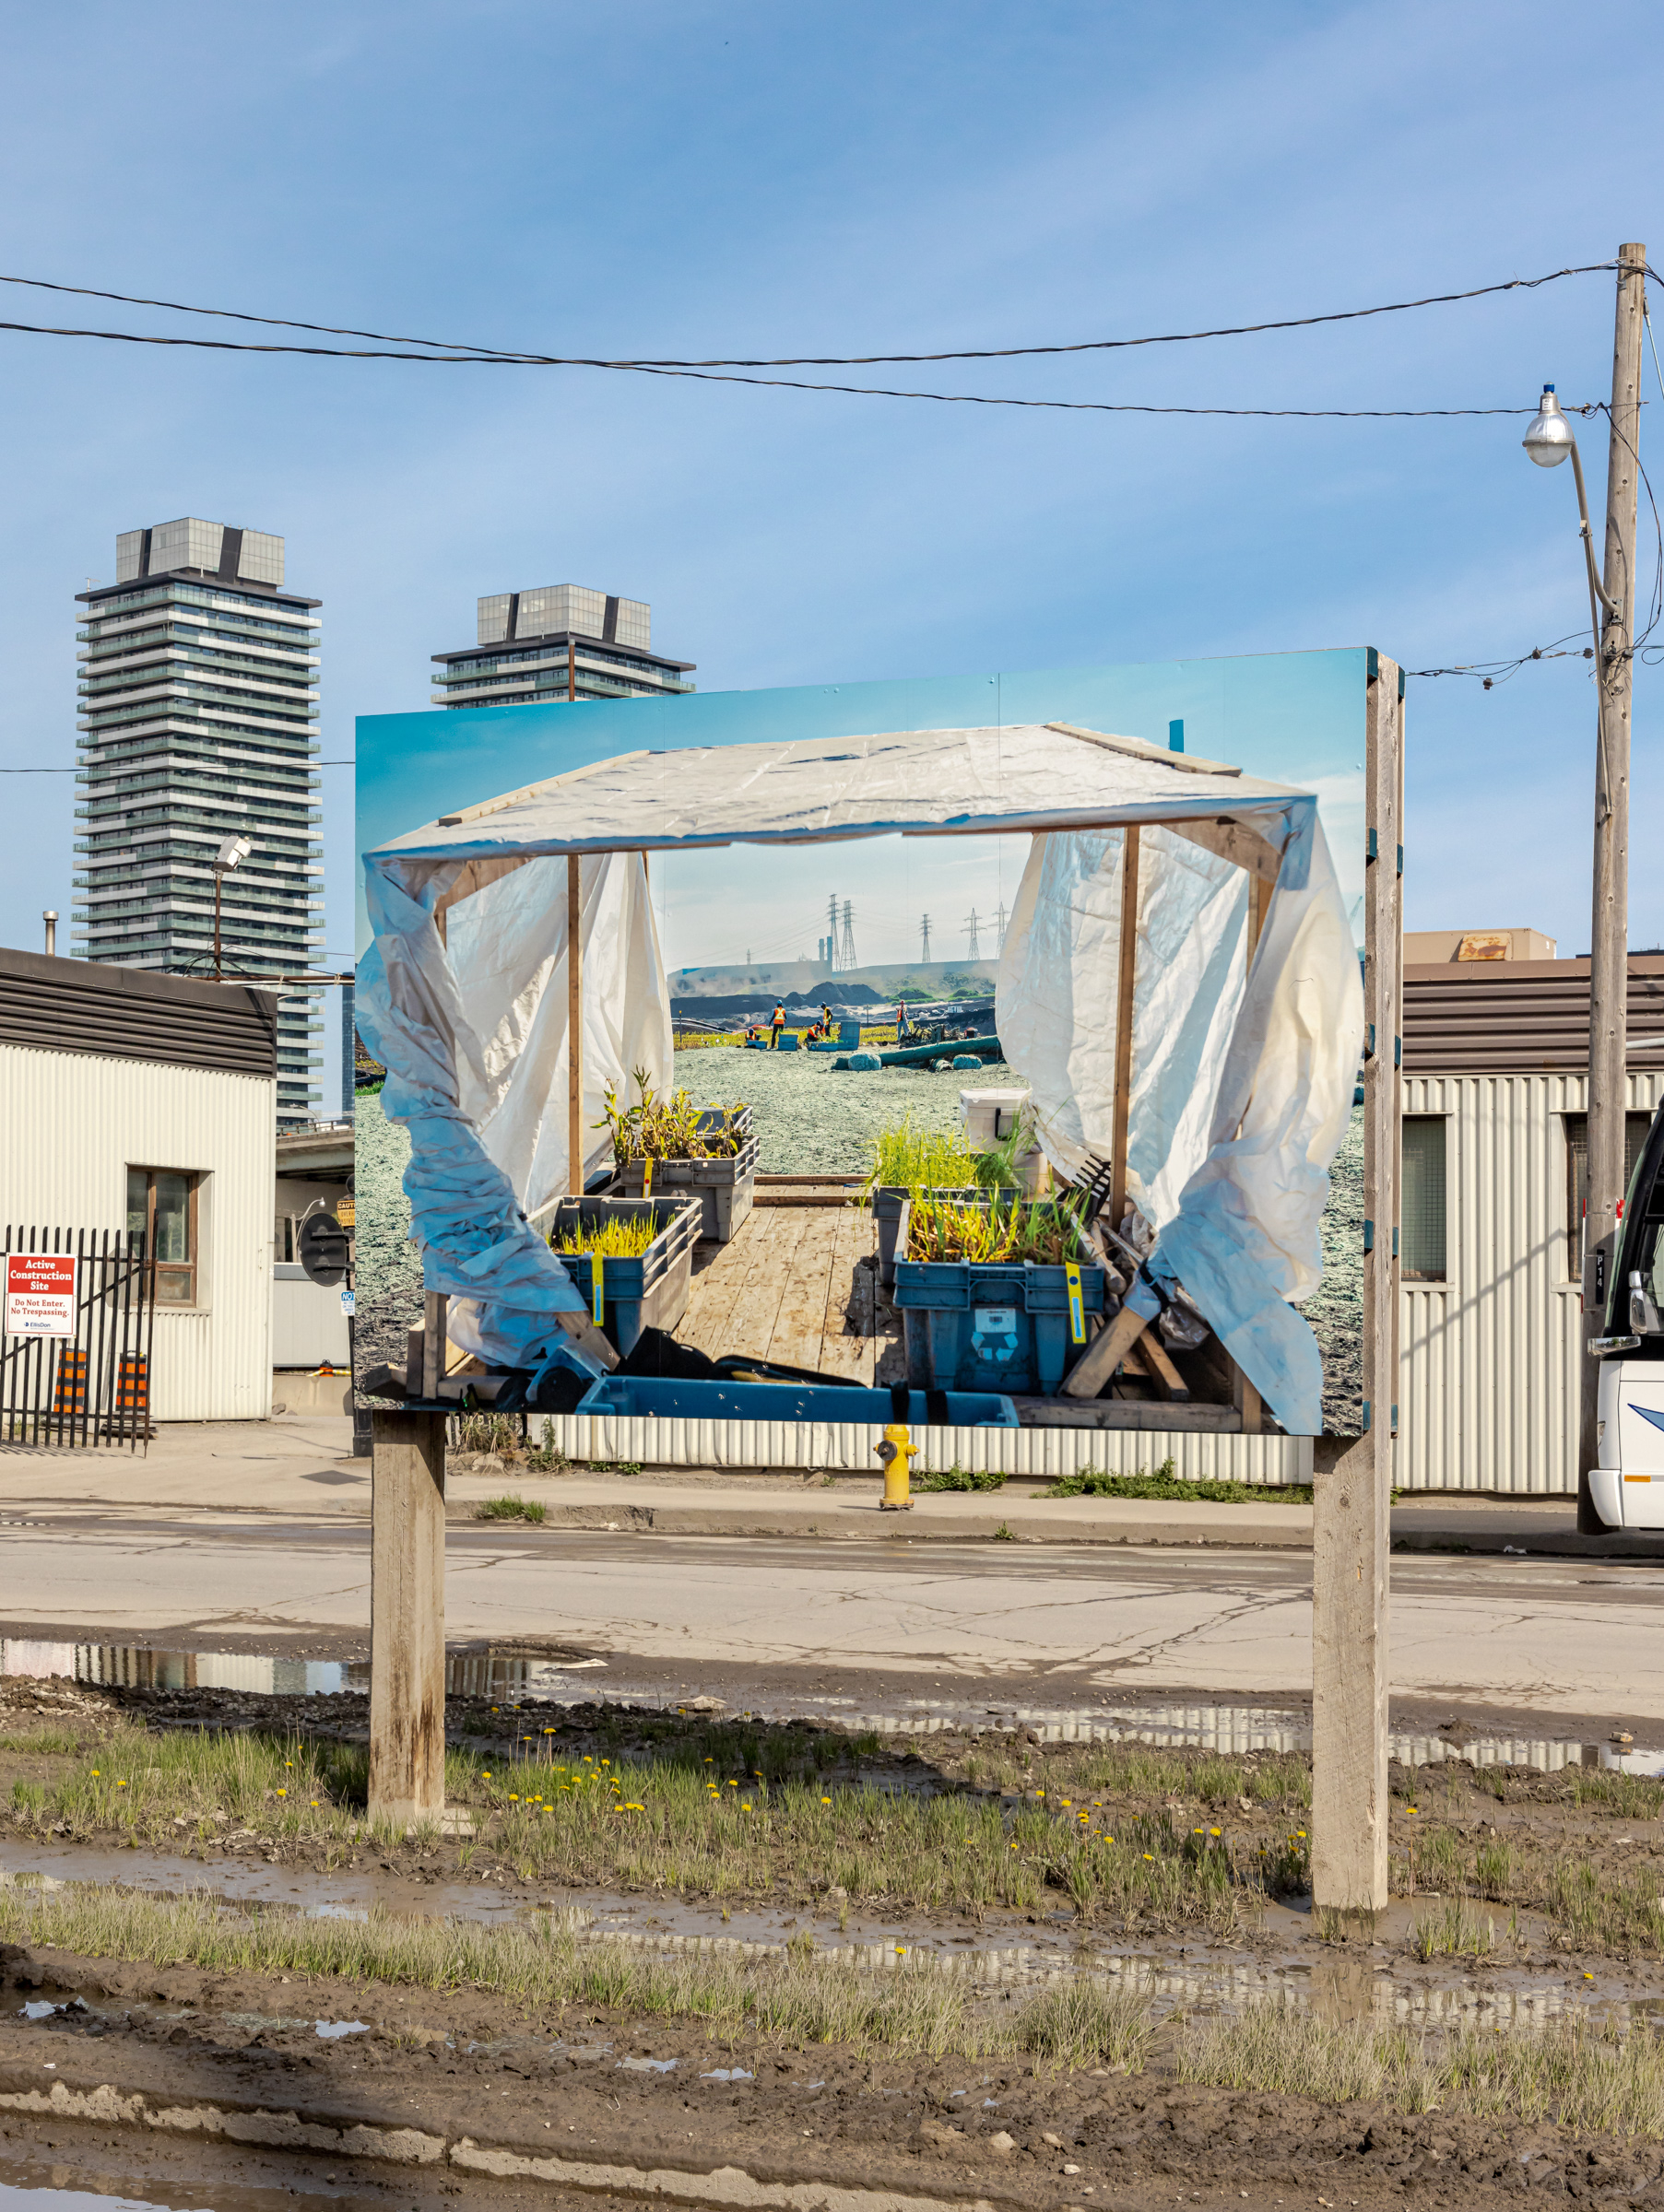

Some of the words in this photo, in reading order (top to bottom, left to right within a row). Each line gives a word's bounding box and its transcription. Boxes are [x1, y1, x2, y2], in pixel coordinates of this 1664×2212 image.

[26, 1259, 55, 1269] Active
[10, 1270, 72, 1280] Construction
[30, 1281, 49, 1290] Site
[22, 1307, 69, 1318] Trespassing.
